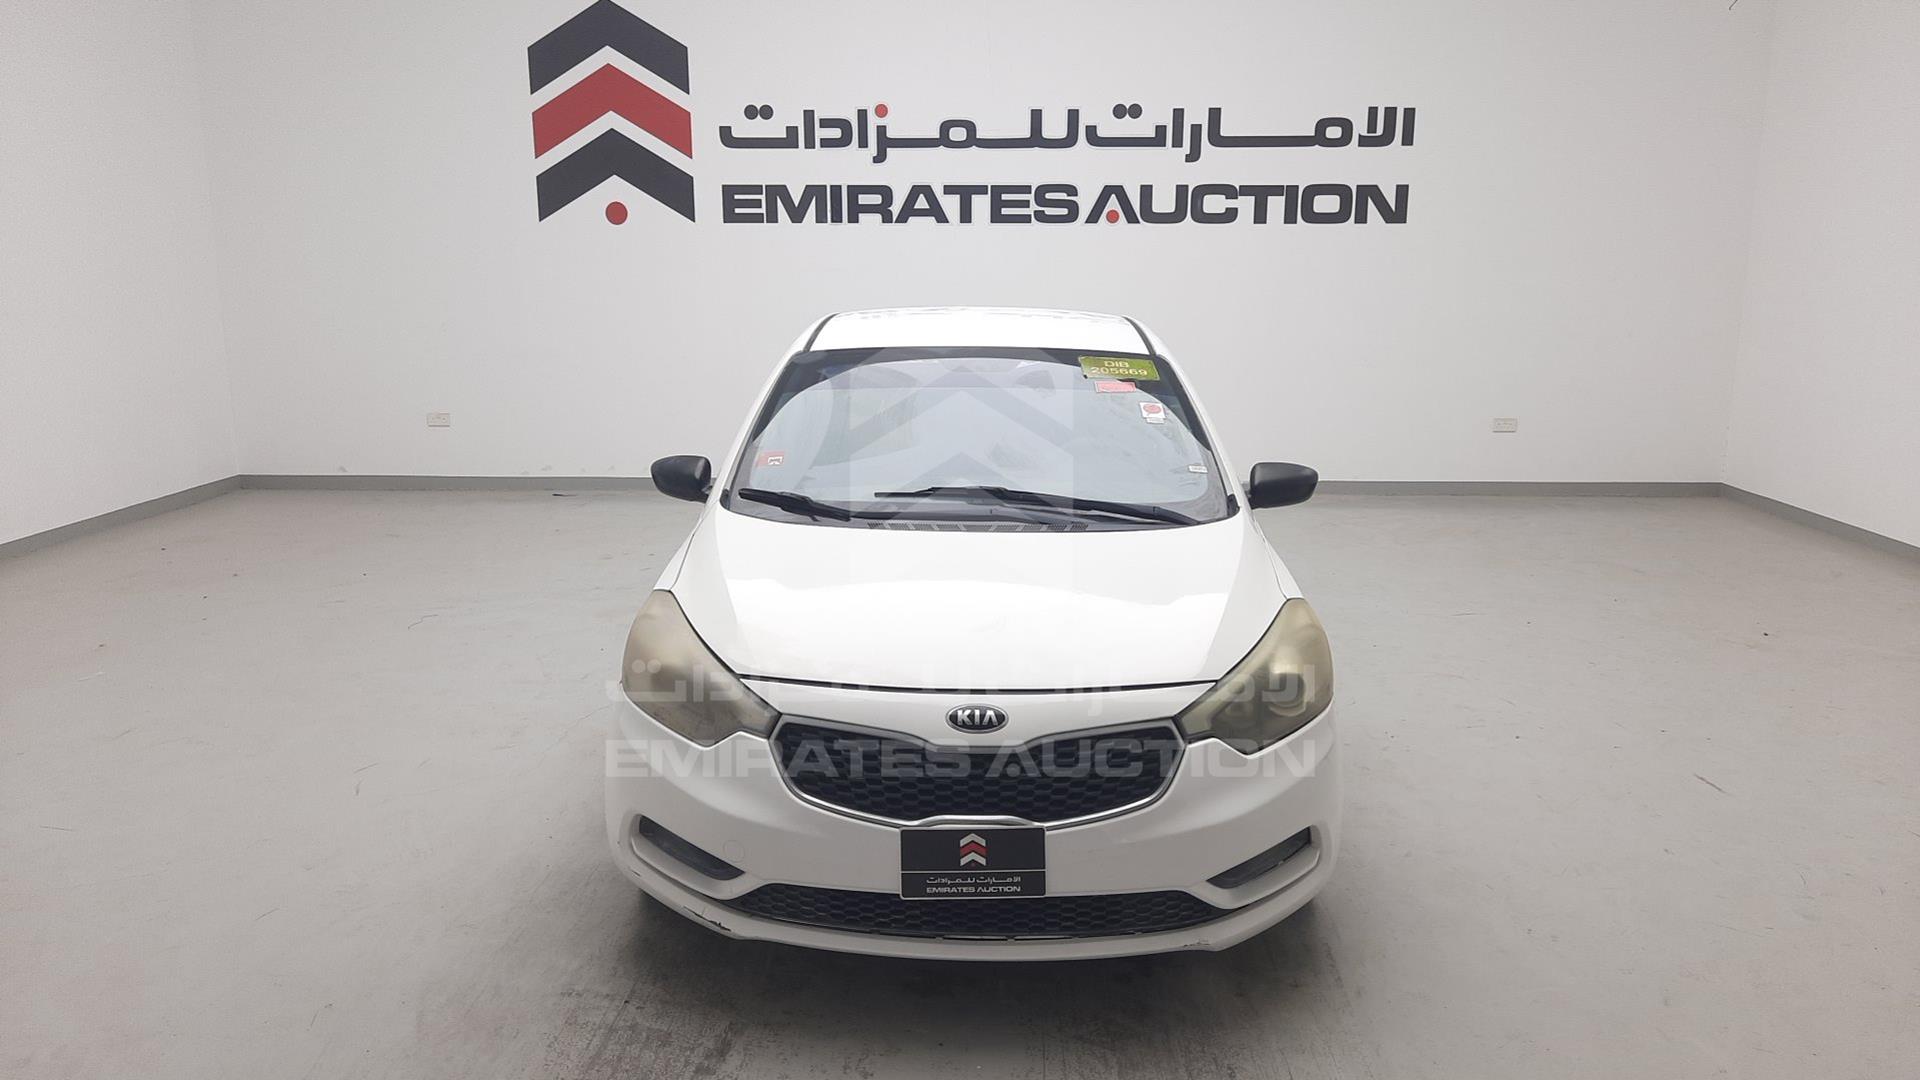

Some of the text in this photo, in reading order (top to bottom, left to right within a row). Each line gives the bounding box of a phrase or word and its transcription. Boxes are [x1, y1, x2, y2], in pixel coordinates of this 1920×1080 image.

[719, 104, 1080, 164] للمزادات
[721, 184, 1409, 224] EMIRATES AUCTION
[956, 709, 1000, 726] KIA
